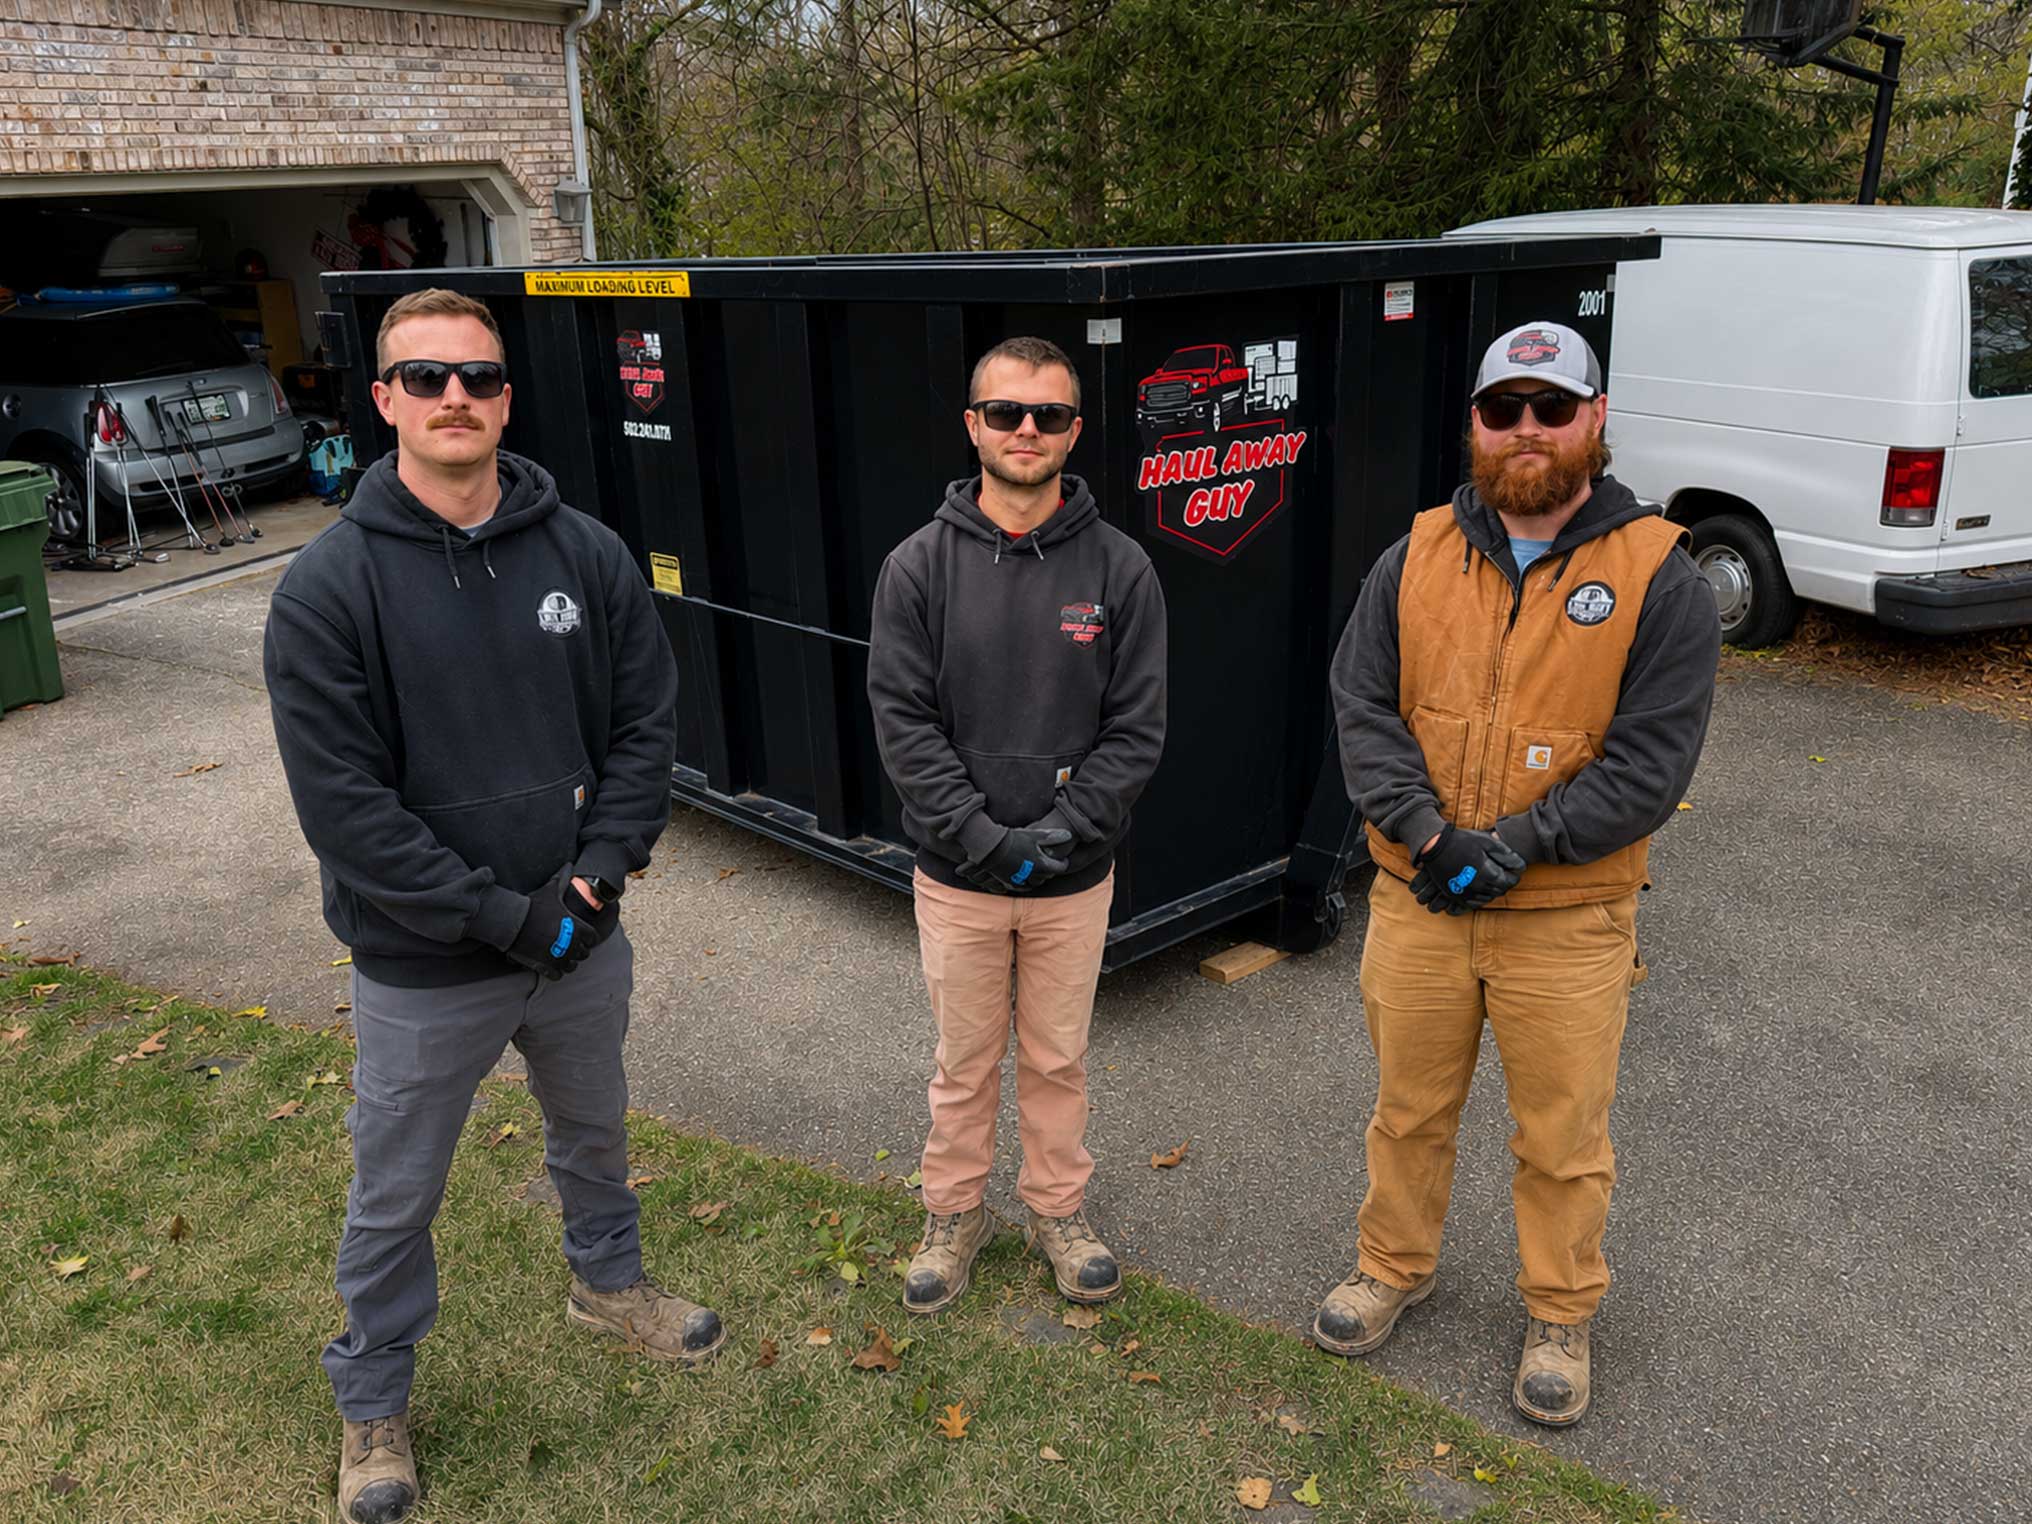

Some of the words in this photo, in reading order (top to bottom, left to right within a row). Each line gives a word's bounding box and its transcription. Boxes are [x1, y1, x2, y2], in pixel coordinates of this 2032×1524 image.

[536, 280, 584, 293] MAXIMUM
[587, 281, 636, 294] LOADING
[640, 281, 675, 294] LEVEL
[1577, 289, 1606, 317] 2001
[1139, 447, 1217, 490] HAUL
[1222, 432, 1307, 476] AWAY
[1184, 480, 1255, 527] GUY
